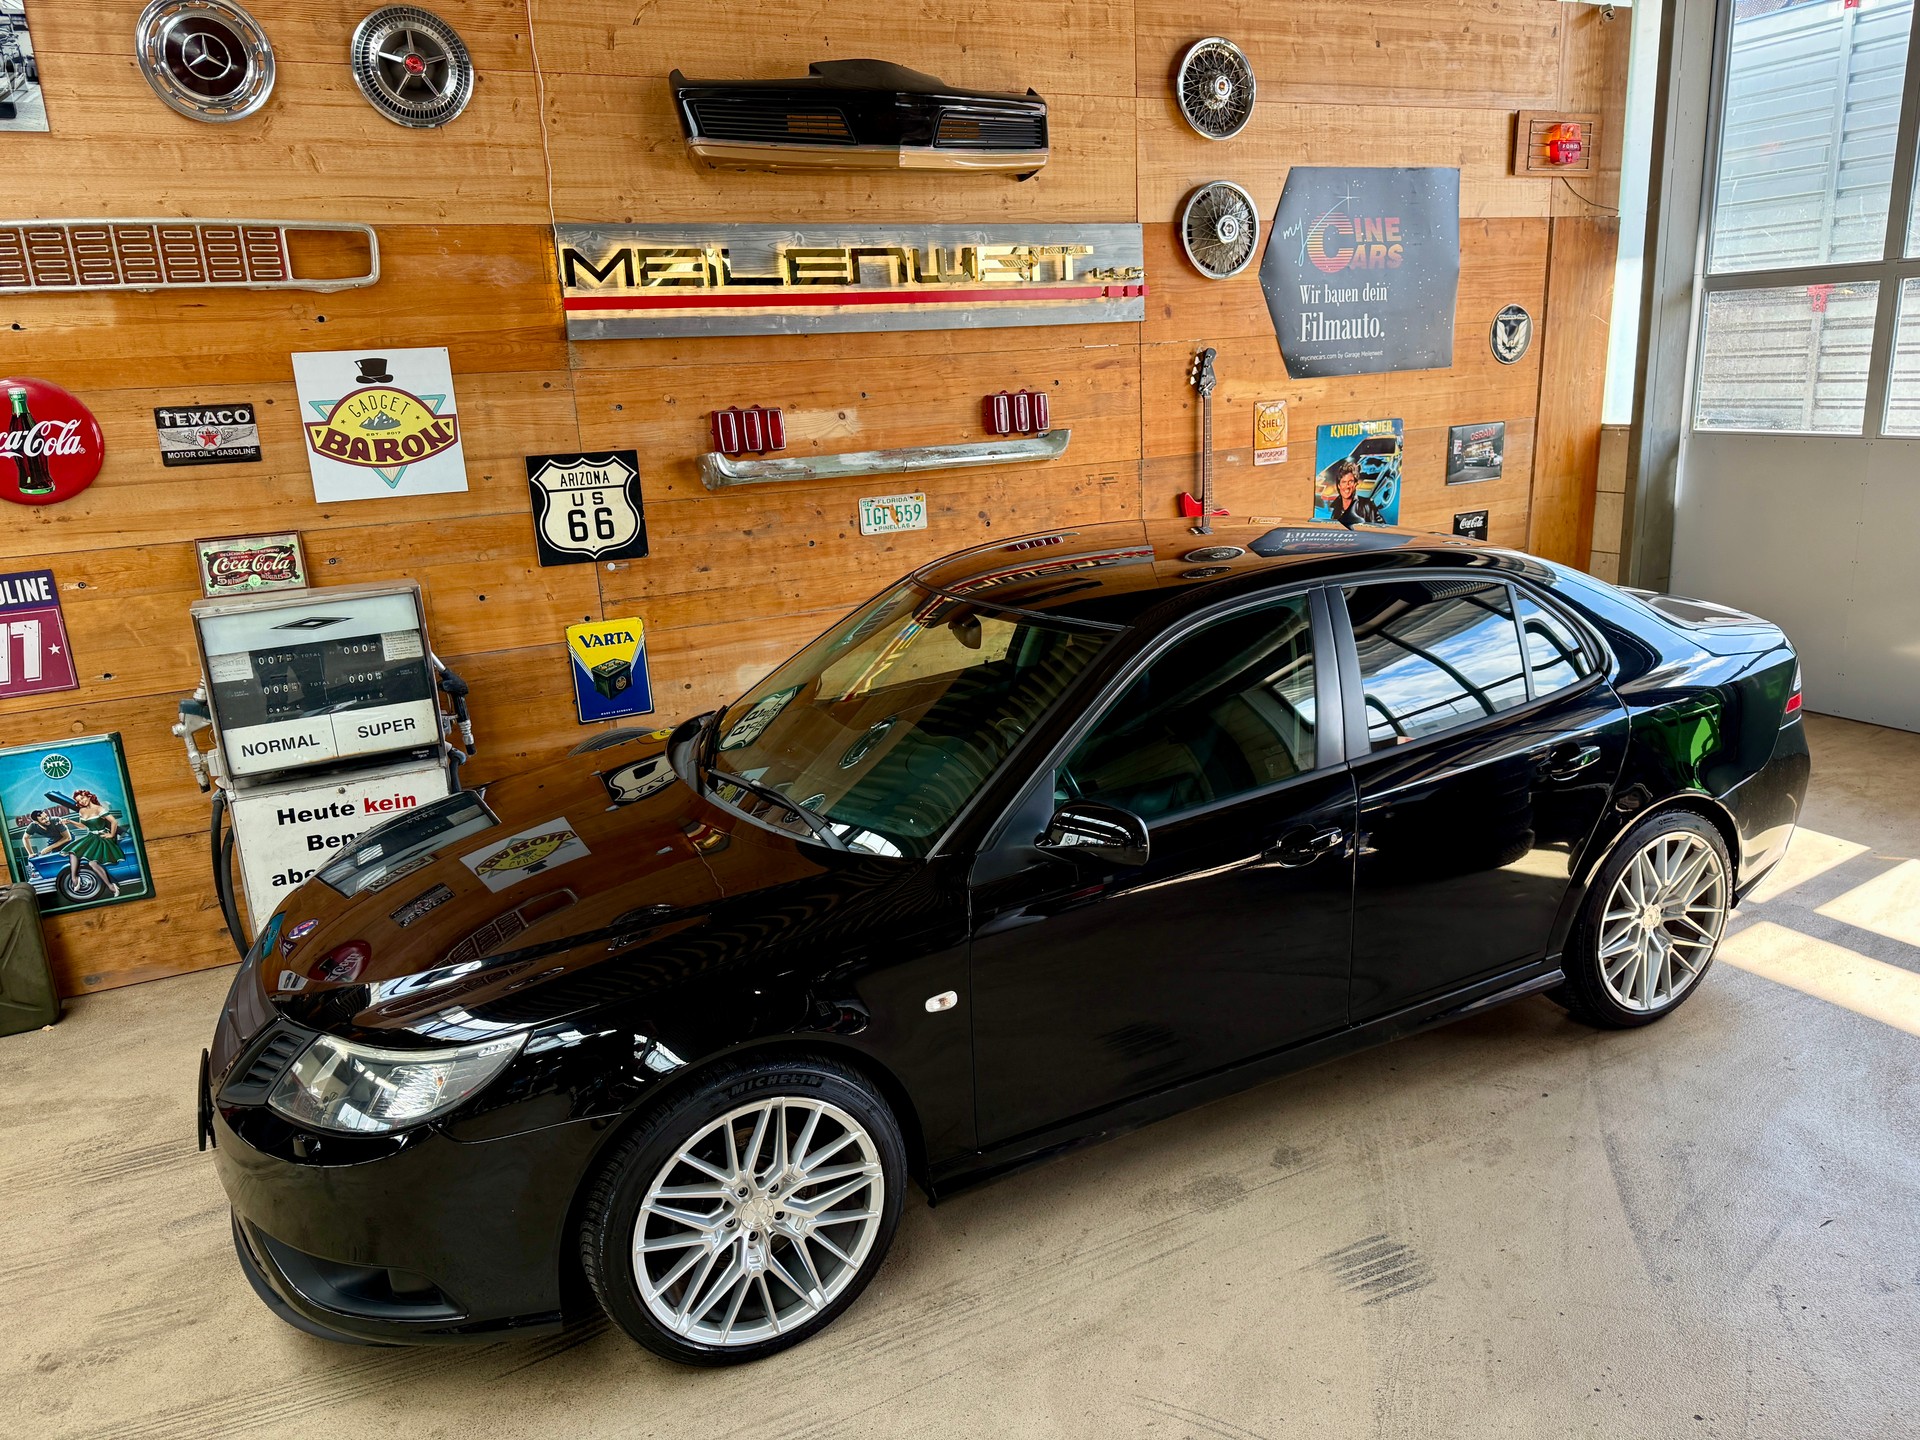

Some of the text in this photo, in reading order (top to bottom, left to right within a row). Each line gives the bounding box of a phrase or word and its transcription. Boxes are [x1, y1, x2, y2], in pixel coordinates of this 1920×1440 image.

[1282, 217, 1305, 267] my
[1299, 282, 1388, 304] Wir bauen dein
[1299, 311, 1386, 343] Filmauto.
[1299, 353, 1337, 361] mycinecars.com
[1337, 351, 1344, 359] by
[1344, 351, 1360, 359] Garage
[348, 394, 411, 418] GADGET
[160, 409, 251, 427] TEXACO
[318, 421, 453, 463] BARON
[1470, 426, 1496, 441] OSRAM
[167, 450, 197, 459] MOTOR
[216, 447, 257, 456] GASOLINE
[560, 470, 611, 487] ARIZONA
[877, 496, 908, 504] FLORIDA
[567, 507, 615, 542] 66
[878, 523, 911, 531] PINELLAS
[1459, 515, 1485, 530] Coca-Cola
[212, 551, 291, 576] Coca-Cola
[578, 631, 635, 649] VARTA
[357, 717, 416, 739] SUPER
[241, 733, 321, 758] NORMAL
[276, 794, 417, 825] Heute kein
[306, 831, 364, 852] Ben
[731, 1074, 820, 1096] MICHELIN
